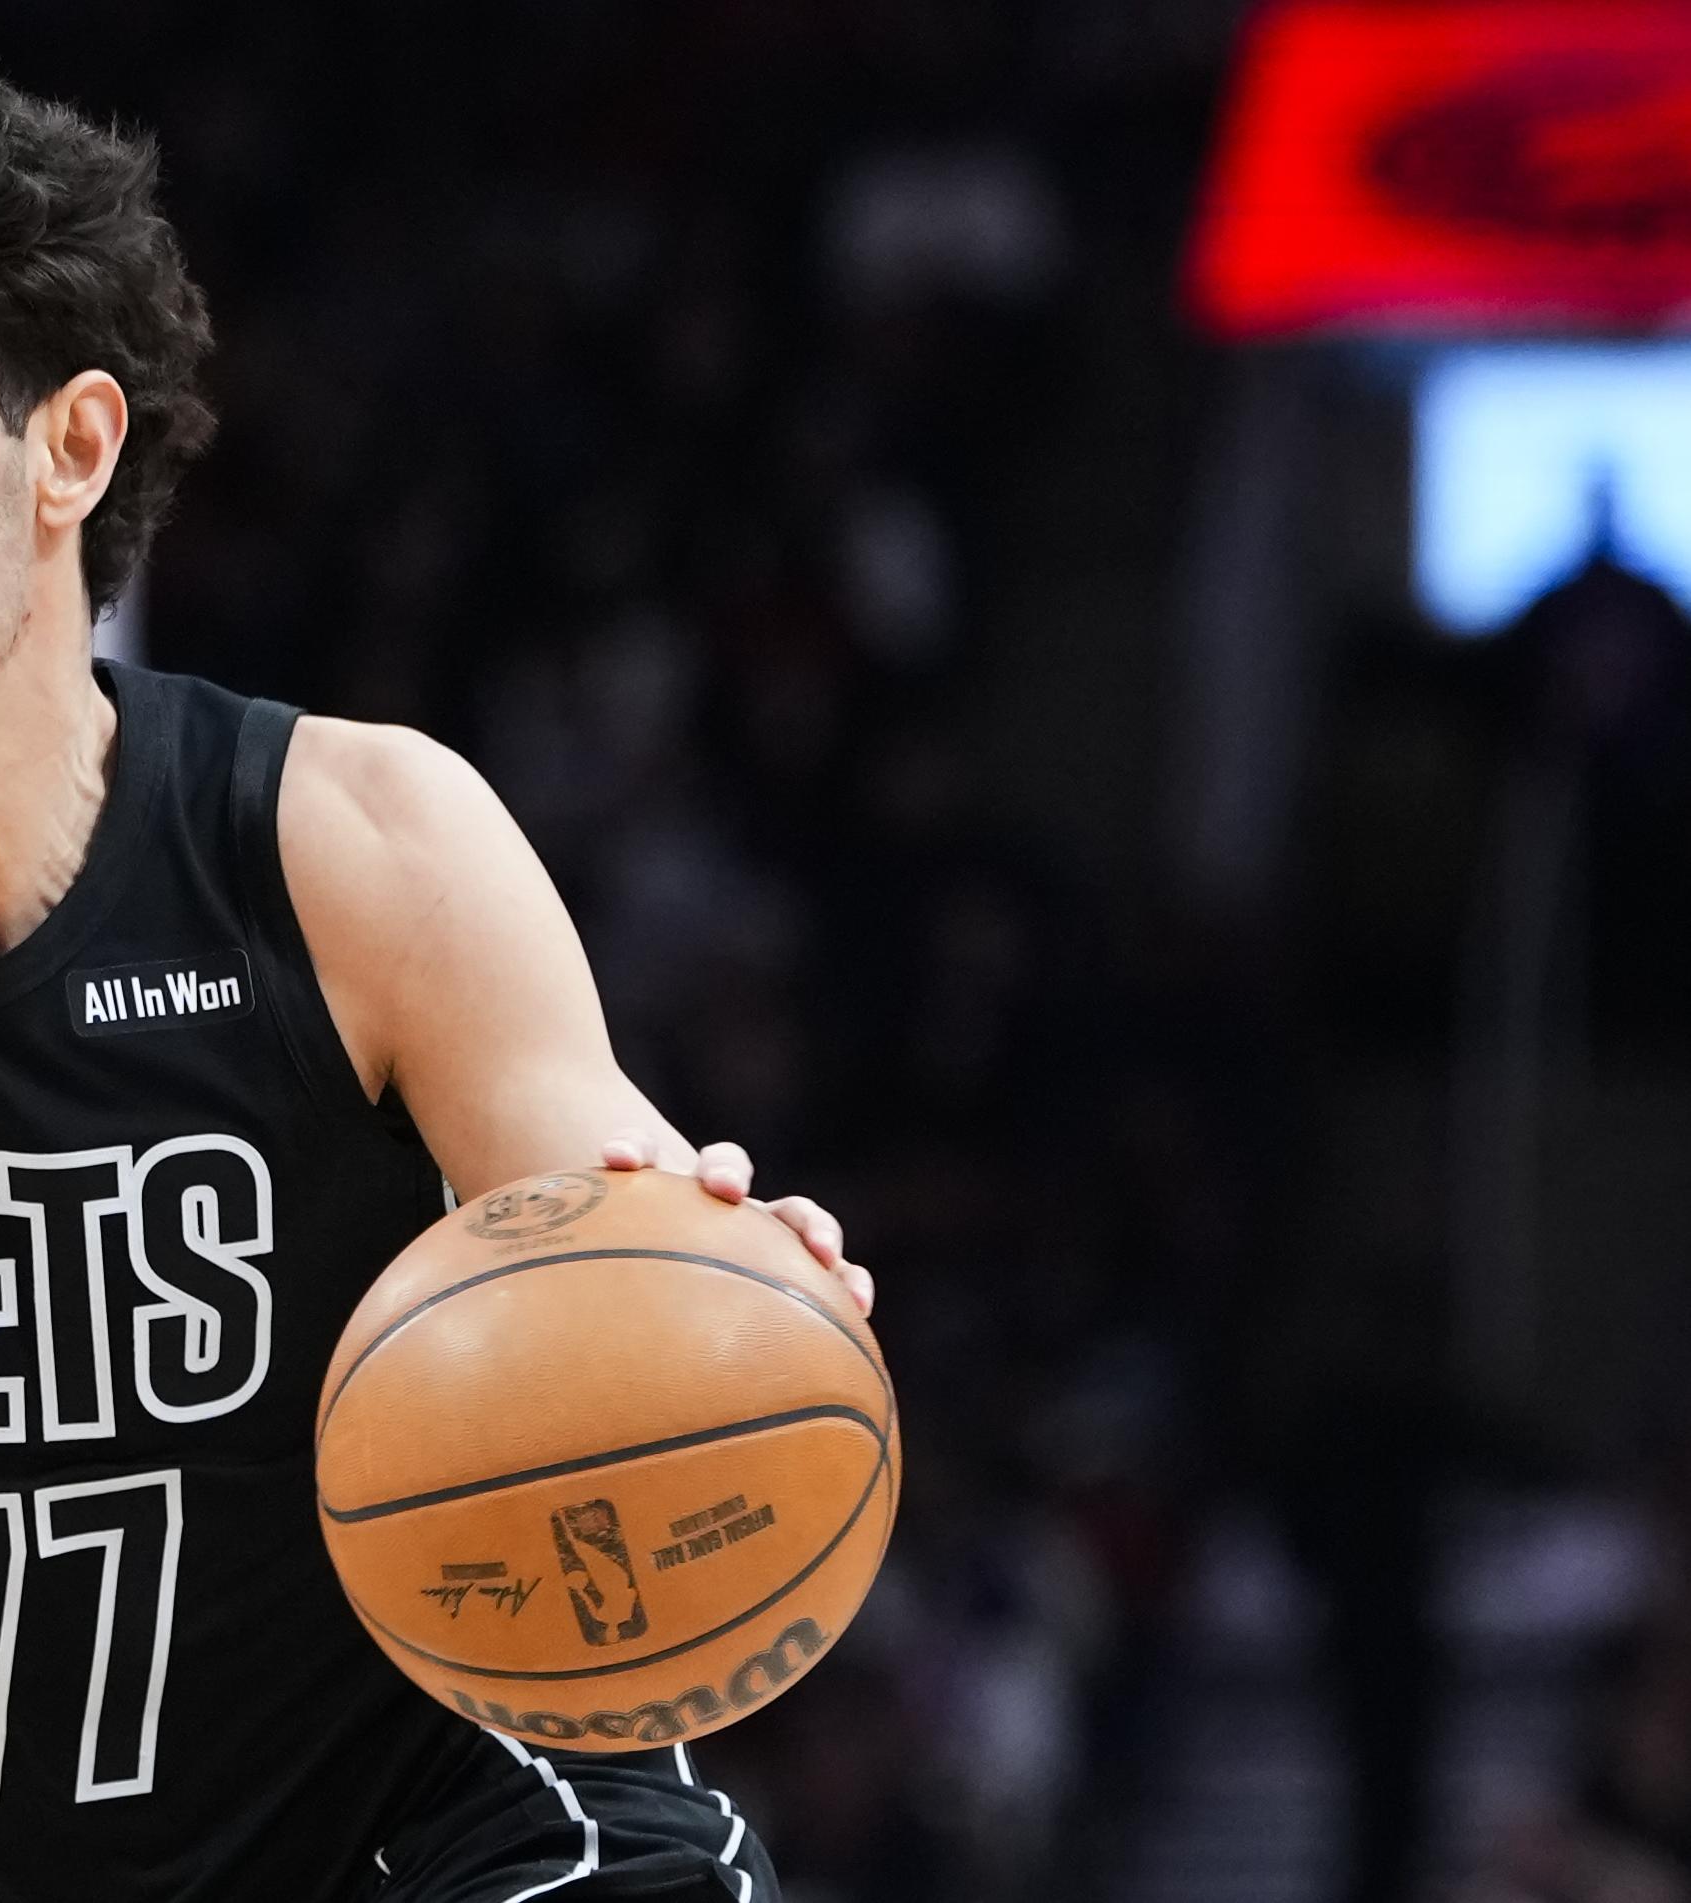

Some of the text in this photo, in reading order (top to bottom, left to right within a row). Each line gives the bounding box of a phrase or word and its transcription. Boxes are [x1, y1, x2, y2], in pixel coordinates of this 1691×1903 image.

[85, 970, 241, 1024] All In Won
